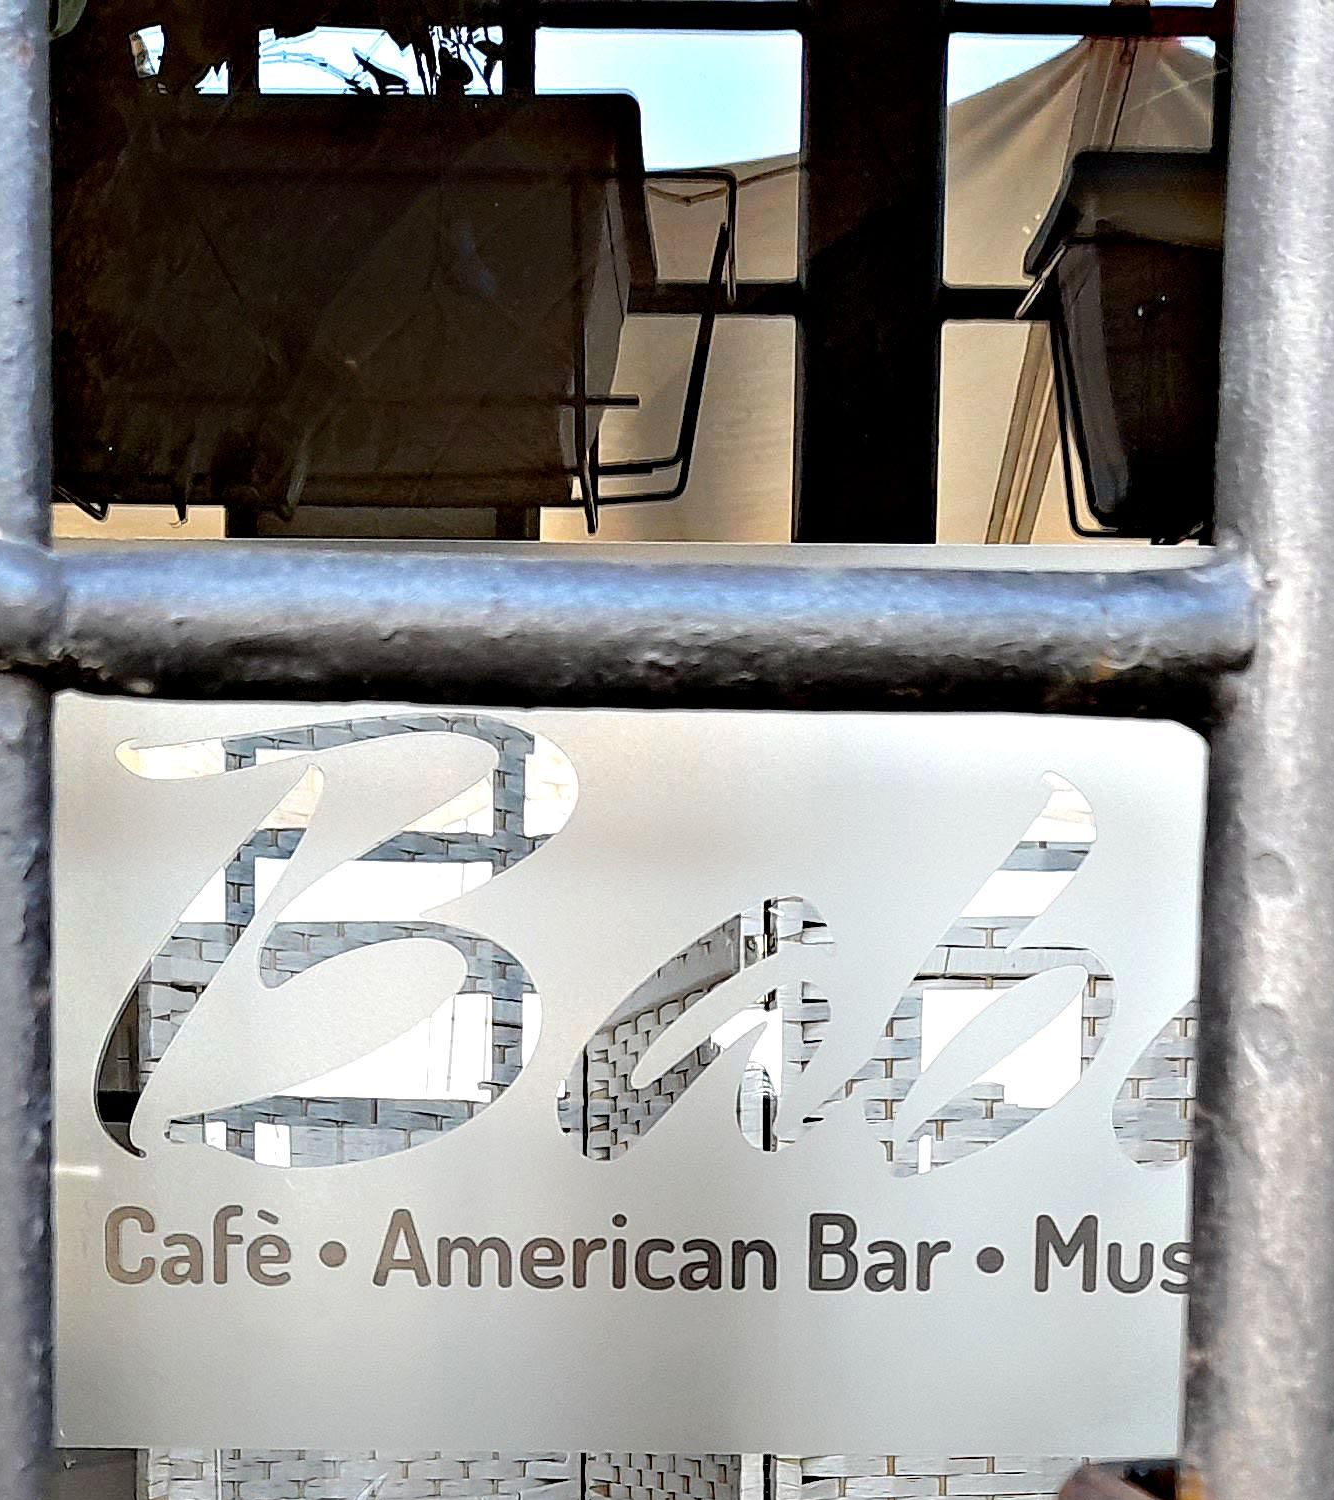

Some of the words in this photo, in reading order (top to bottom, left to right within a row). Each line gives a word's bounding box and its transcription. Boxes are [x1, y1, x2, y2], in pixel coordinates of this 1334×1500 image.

[105, 1205, 291, 1286] Cafè
[373, 1208, 777, 1292] American
[809, 1213, 951, 1292] Bar
